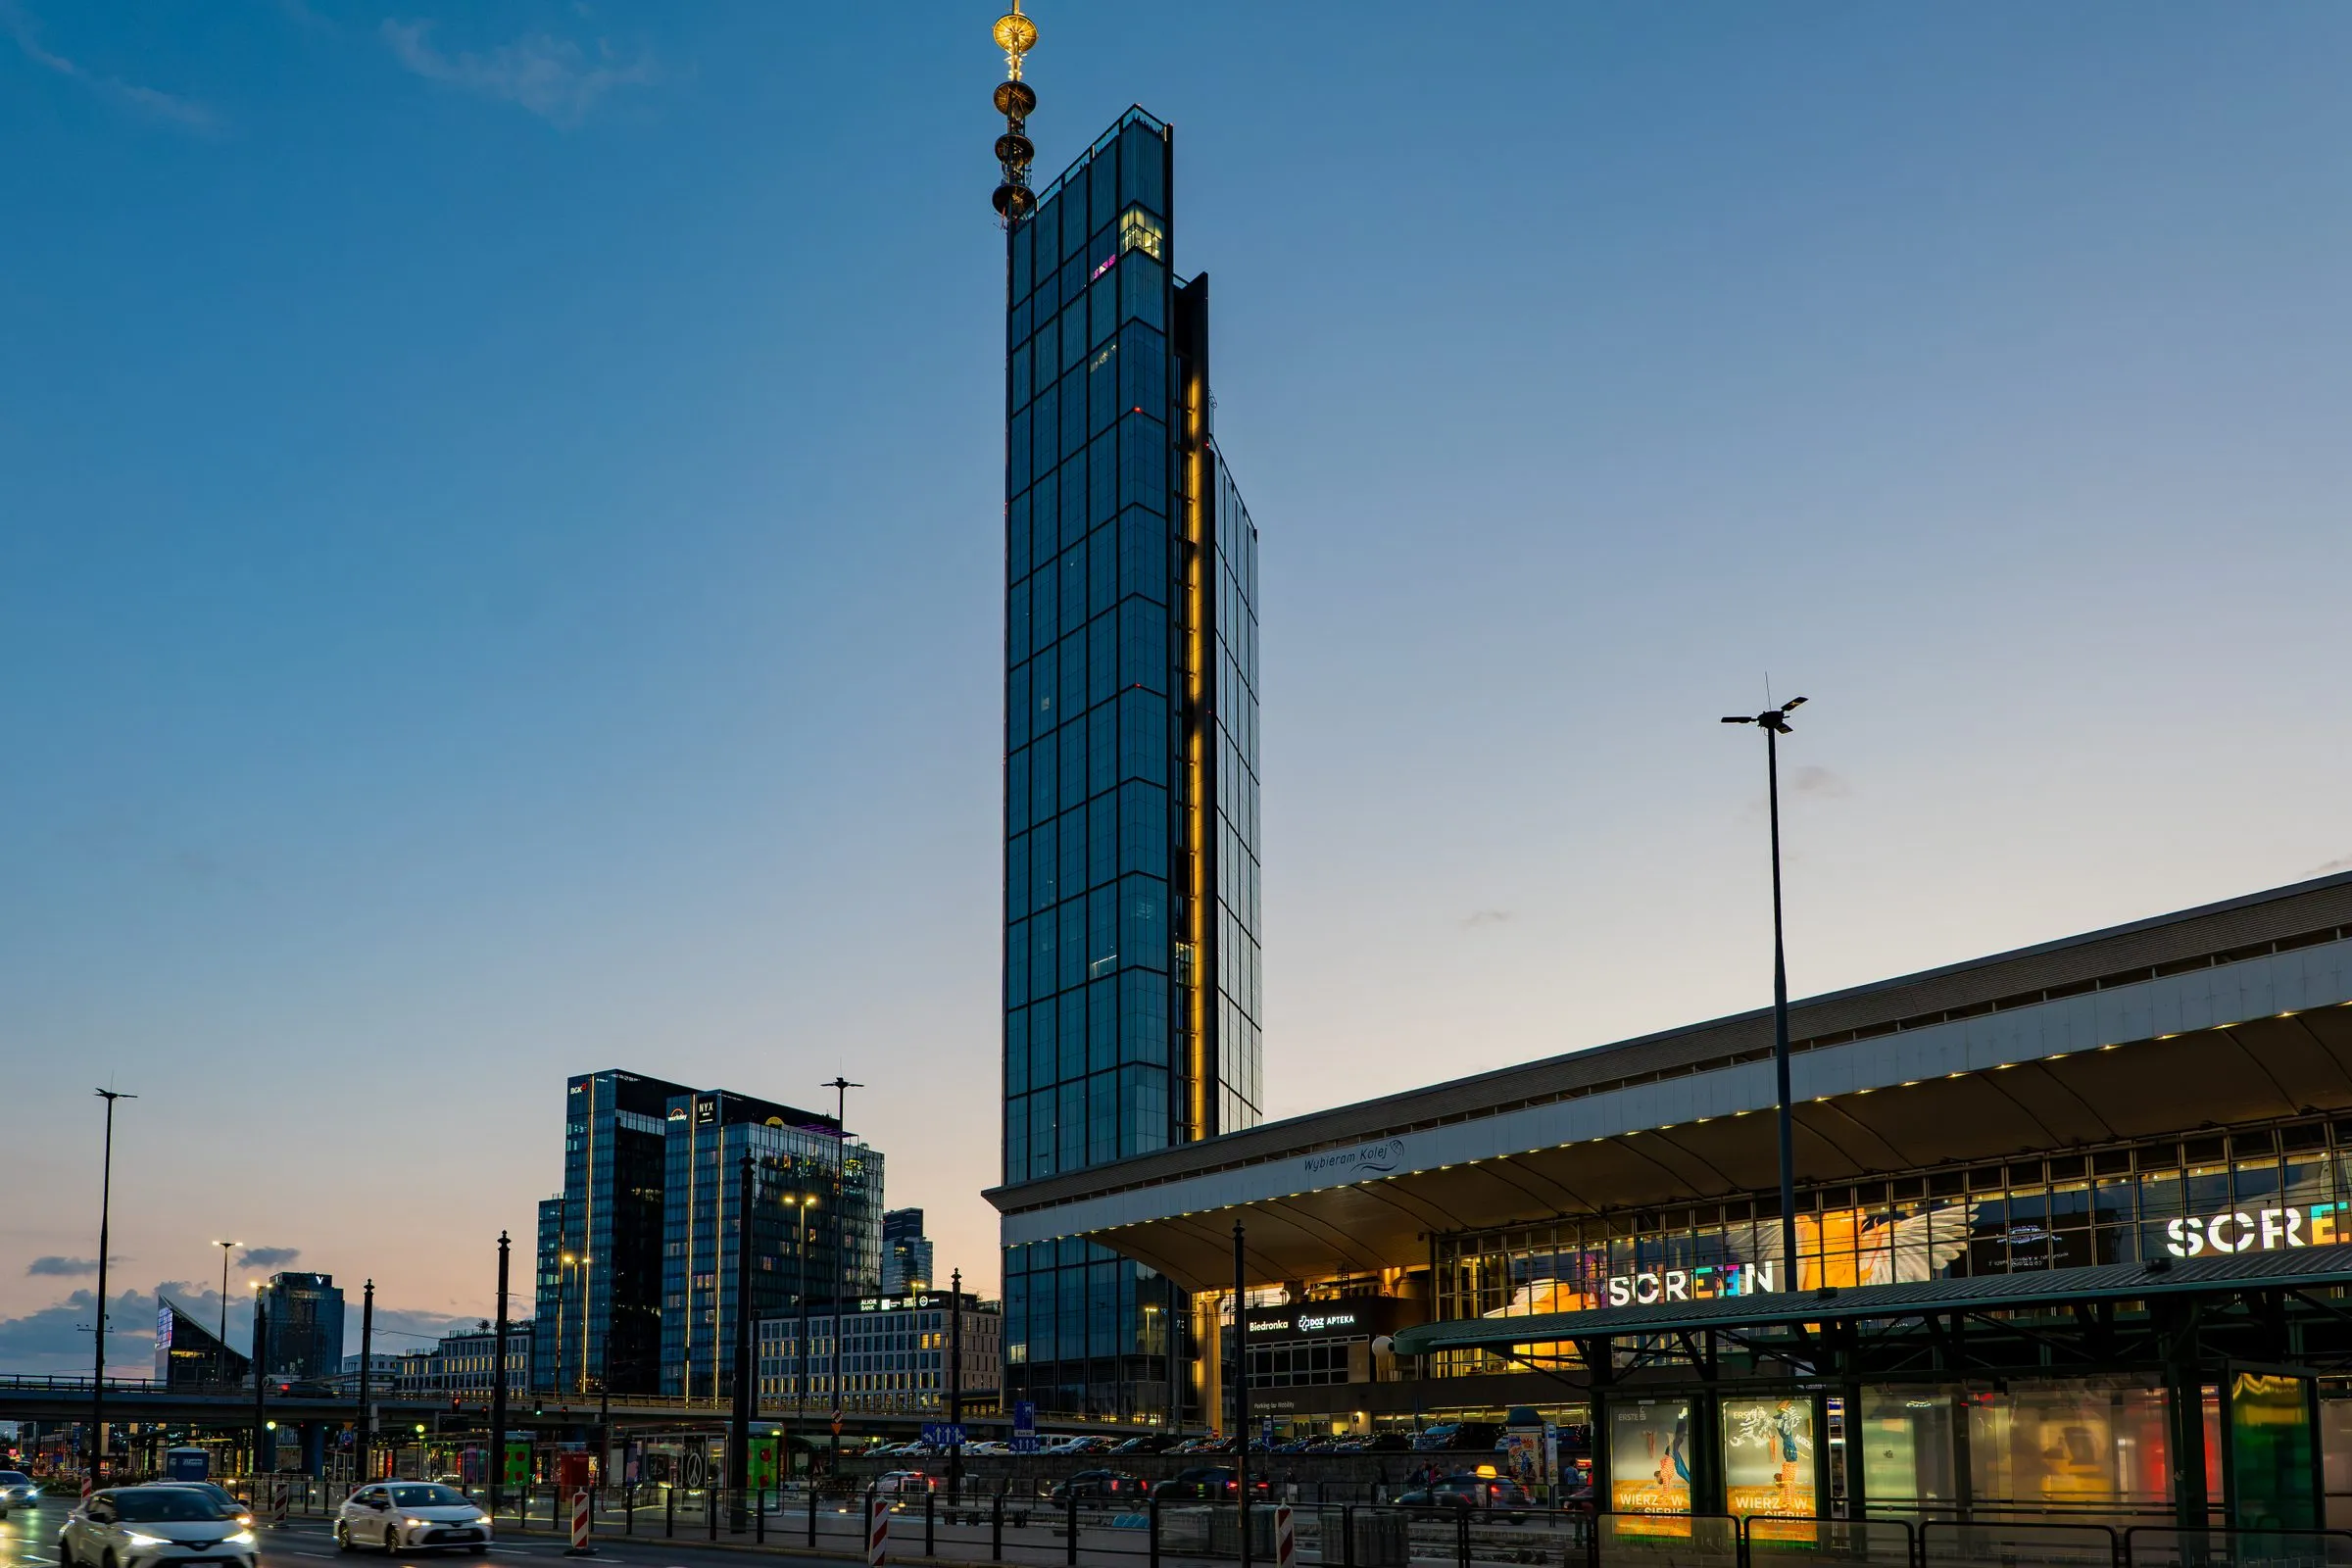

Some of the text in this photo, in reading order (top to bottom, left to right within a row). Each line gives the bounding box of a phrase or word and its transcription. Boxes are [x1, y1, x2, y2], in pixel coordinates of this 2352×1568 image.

[570, 1086, 582, 1095] BGK
[699, 1102, 713, 1112] NYX
[1304, 1145, 1389, 1172] Wybieram Kolej
[2167, 1201, 2350, 1257] SCRE
[1327, 1315, 1354, 1324] APTEKA
[1250, 1320, 1289, 1332] Biedronka
[1620, 1494, 1684, 1505] WIERZ W
[1736, 1496, 1808, 1510] WIERZ W
